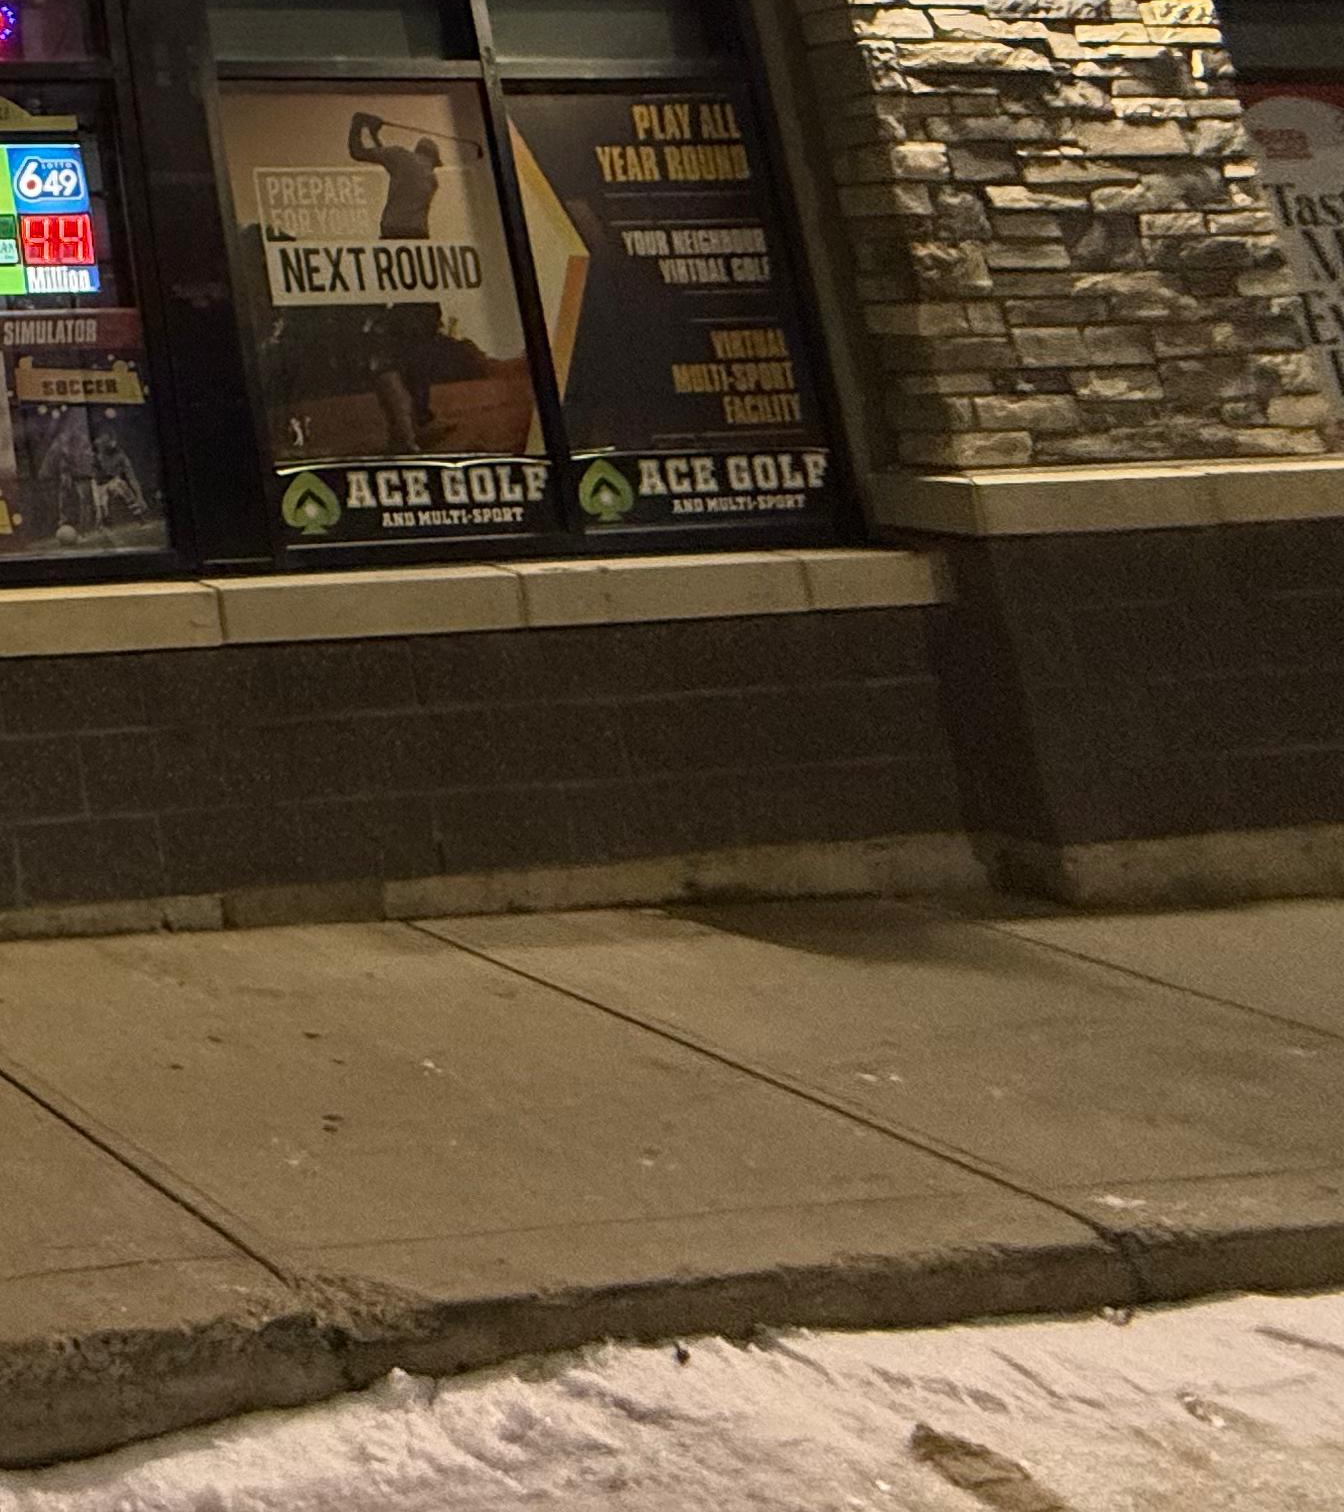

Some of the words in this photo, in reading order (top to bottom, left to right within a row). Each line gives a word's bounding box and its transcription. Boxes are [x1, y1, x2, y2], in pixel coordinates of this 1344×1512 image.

[631, 104, 691, 140] PLAY
[700, 103, 742, 139] ALL
[596, 145, 661, 182] YEAR
[664, 144, 751, 181] ROUND
[19, 159, 79, 199] 649
[265, 175, 368, 205] PREPARE
[270, 207, 311, 237] FOR
[313, 207, 371, 235] YOUR
[22, 216, 86, 265] 44
[621, 230, 670, 257] YOUR
[26, 267, 93, 293] Million
[279, 246, 367, 293] NEXT
[373, 244, 483, 290] ROUND
[3, 318, 97, 345] SIMULATOR
[42, 378, 118, 397] SOCCER
[672, 361, 796, 393] MULTI-SPORT
[723, 393, 801, 424] FACILITY
[346, 468, 432, 508] ACE
[441, 466, 549, 505] GOLF
[638, 456, 720, 495] ACE
[726, 452, 828, 492] GOLF
[382, 511, 417, 528] AND
[418, 506, 525, 526] MULTI-SPORT
[672, 498, 705, 514] AND
[706, 494, 806, 512] MULTI-SPORT
